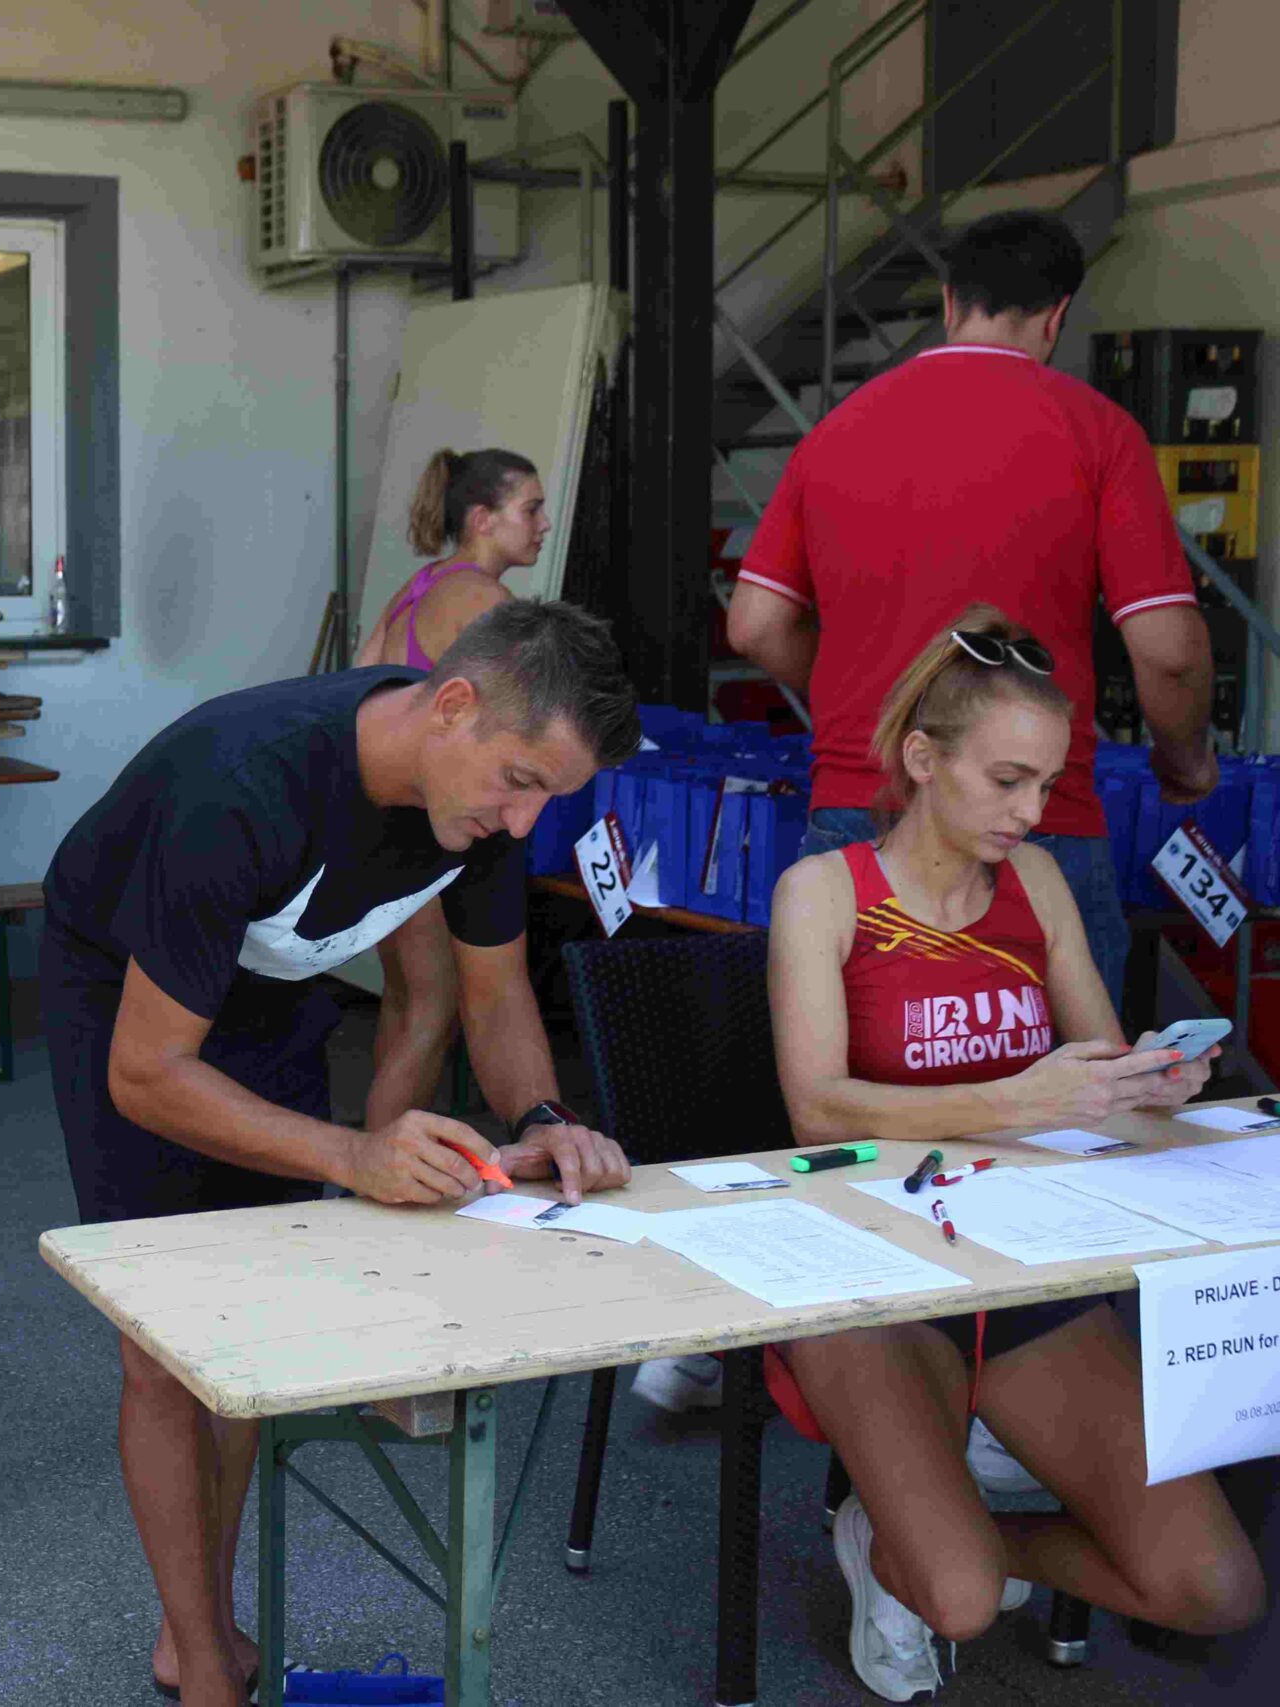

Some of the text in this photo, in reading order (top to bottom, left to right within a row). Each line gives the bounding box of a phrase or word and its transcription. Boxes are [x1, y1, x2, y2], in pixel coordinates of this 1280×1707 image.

[591, 851, 616, 901] 22
[1179, 853, 1230, 918] 134
[932, 986, 1036, 1037] RUN
[904, 1025, 1051, 1070] CIRKOVLJAN
[1195, 1279, 1259, 1305] PRIJAVE
[1167, 1333, 1280, 1366] 2. RED RUN for
